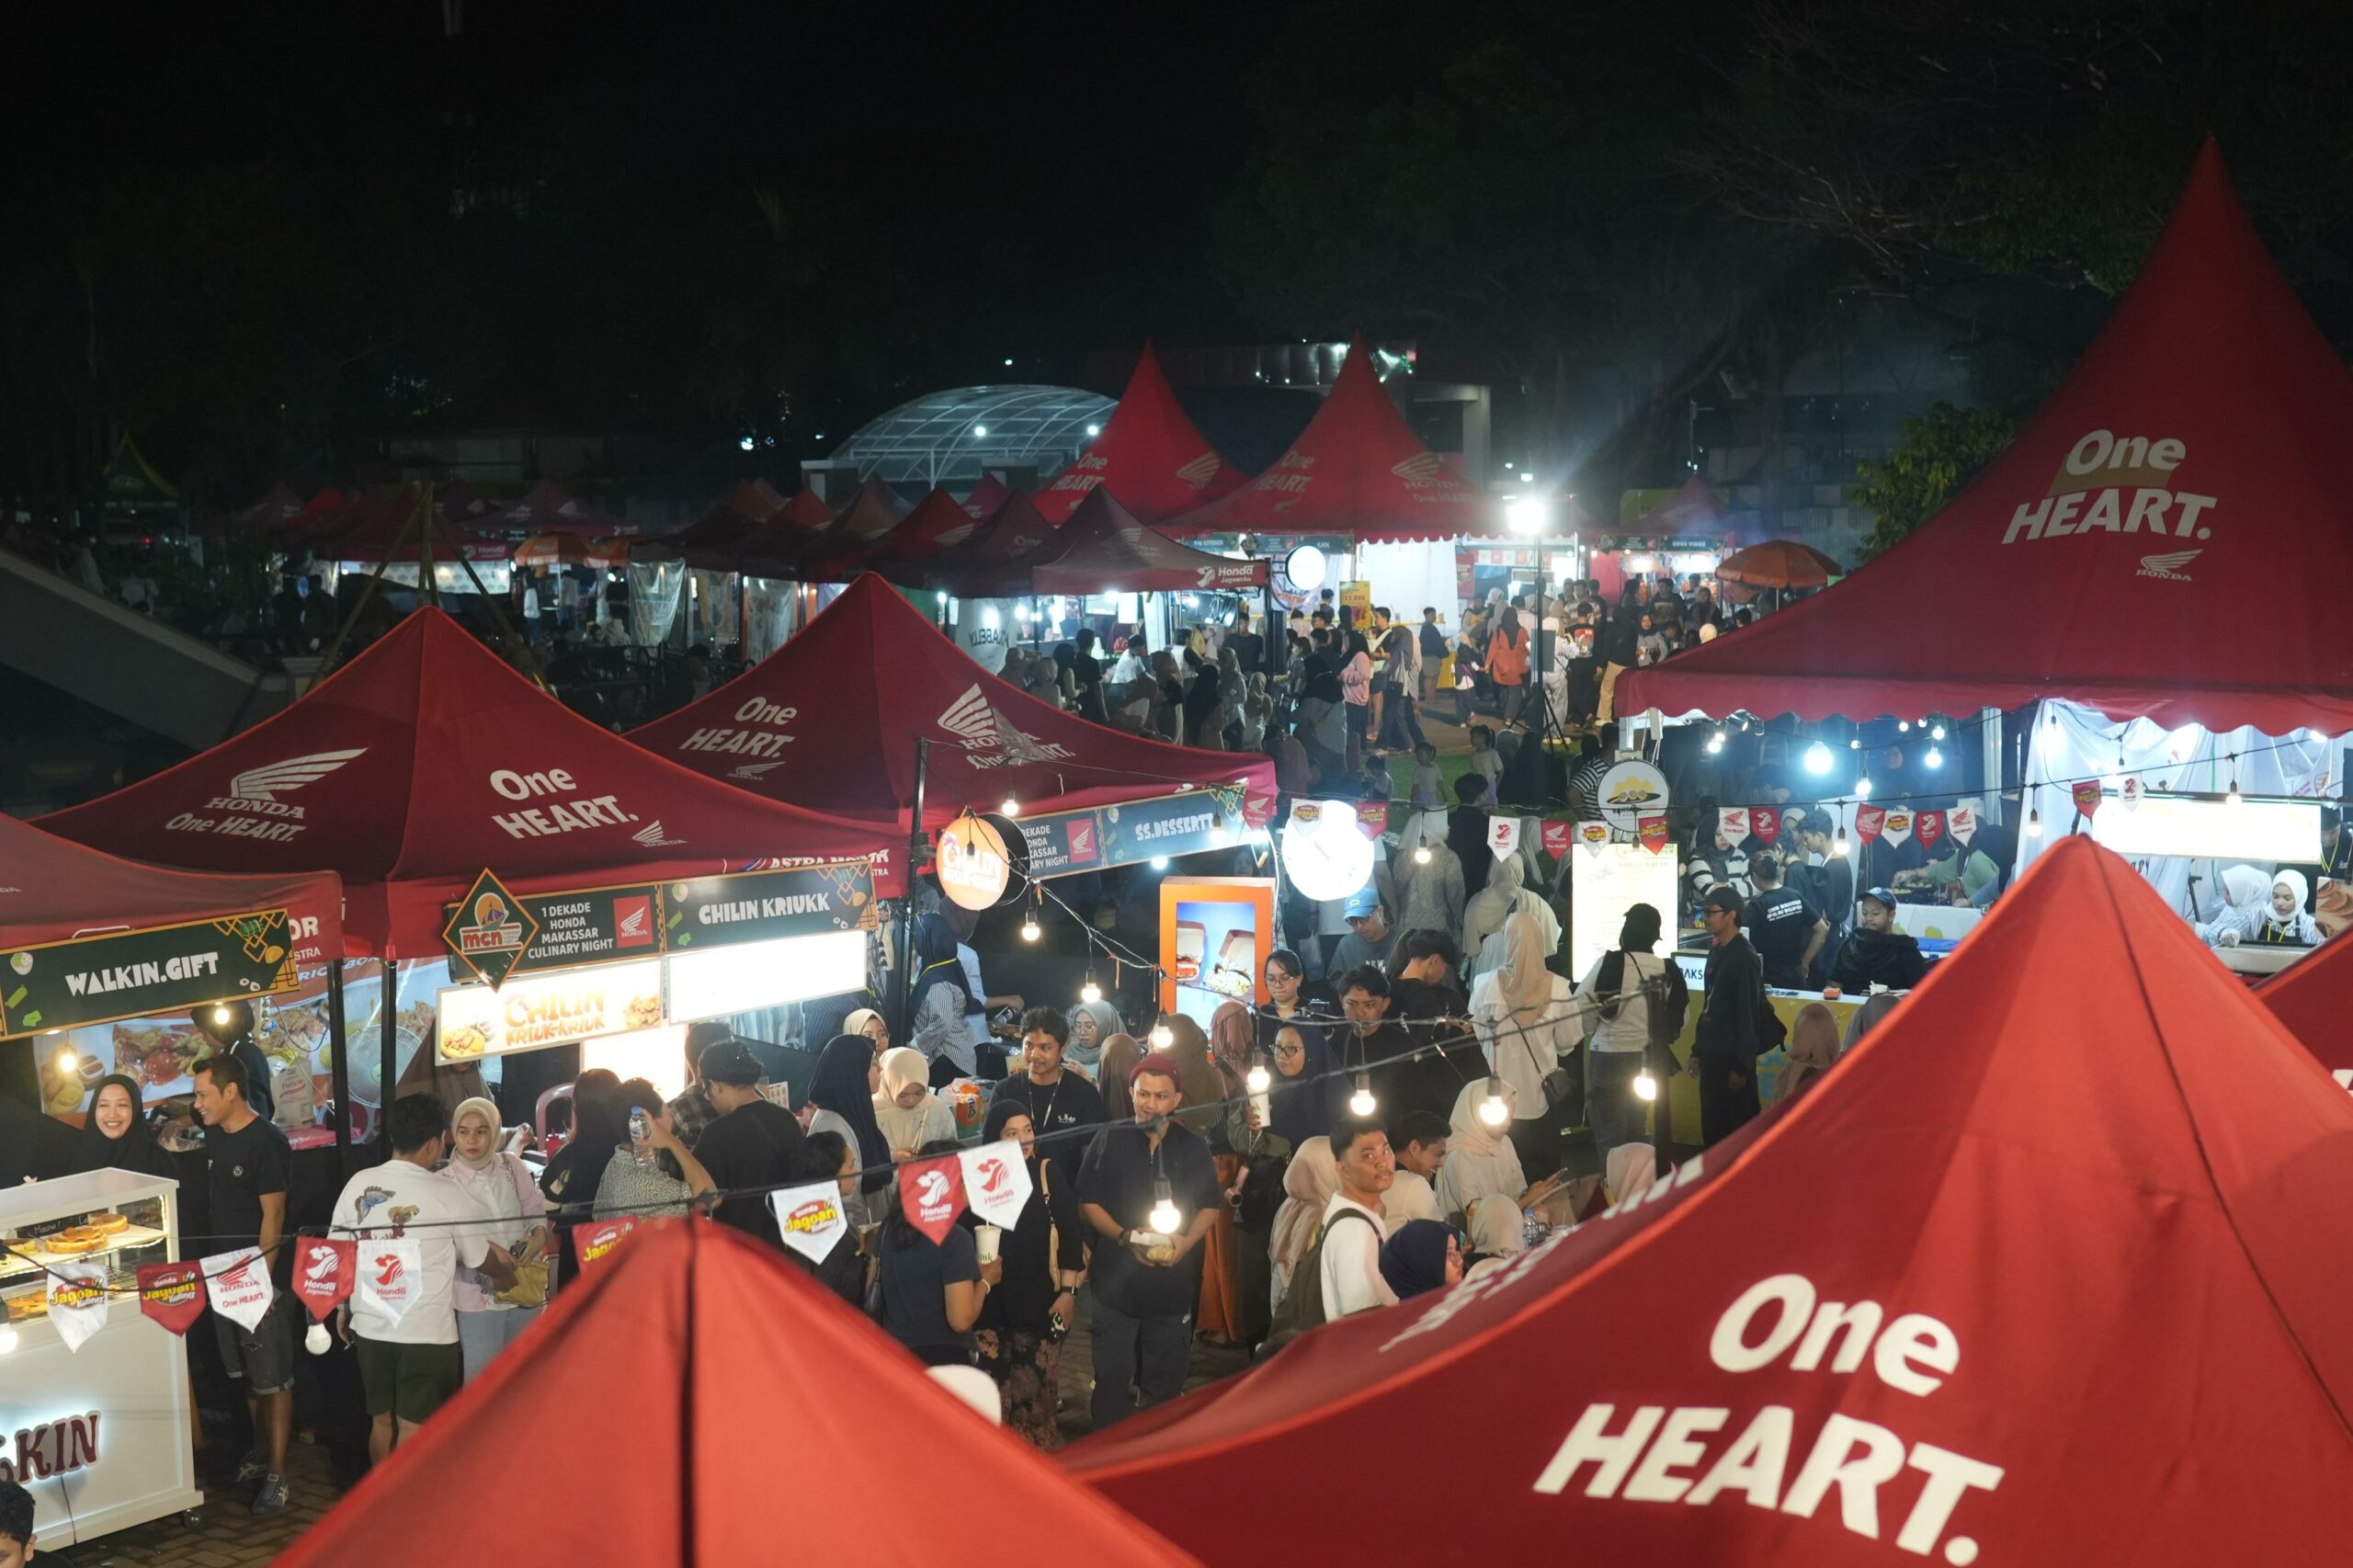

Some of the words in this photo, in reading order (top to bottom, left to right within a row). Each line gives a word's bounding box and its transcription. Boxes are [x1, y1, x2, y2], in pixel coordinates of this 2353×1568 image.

[2066, 429, 2186, 475] One
[2002, 488, 2218, 544] HEART.
[1219, 565, 1254, 577] Honda
[2135, 569, 2192, 582] HONDA
[734, 697, 797, 725] One
[678, 728, 795, 757] HEART.
[490, 768, 577, 800] One
[204, 798, 305, 819] HONDA
[492, 795, 639, 838] HEART.
[165, 813, 214, 832] One
[213, 816, 307, 842] HEART.
[1135, 812, 1213, 841] SS.DESSERTT
[1028, 838, 1049, 847] ONDA
[1046, 855, 1069, 869] NIGHT
[541, 907, 547, 917] 1
[549, 902, 591, 917] DEKADE
[699, 900, 758, 925] CHILIN
[762, 892, 831, 918] KRIUKK
[551, 917, 586, 930] HONDA
[462, 932, 503, 949] mcn
[541, 927, 598, 944] MAKASSAR
[294, 947, 321, 961] STRA
[528, 942, 580, 960] CULINARY
[582, 938, 614, 955] NIGHT
[65, 951, 219, 997] WALKIN.GIFT
[921, 1203, 952, 1217] Honda
[785, 1208, 836, 1233] Jagoan
[153, 1277, 177, 1288] Honda
[220, 1279, 260, 1293] HONDA
[304, 1279, 335, 1290] Honda
[377, 1287, 406, 1296] Honda
[222, 1298, 238, 1309] One
[1710, 1273, 1960, 1397] One
[1532, 1403, 2006, 1567] HEART.
